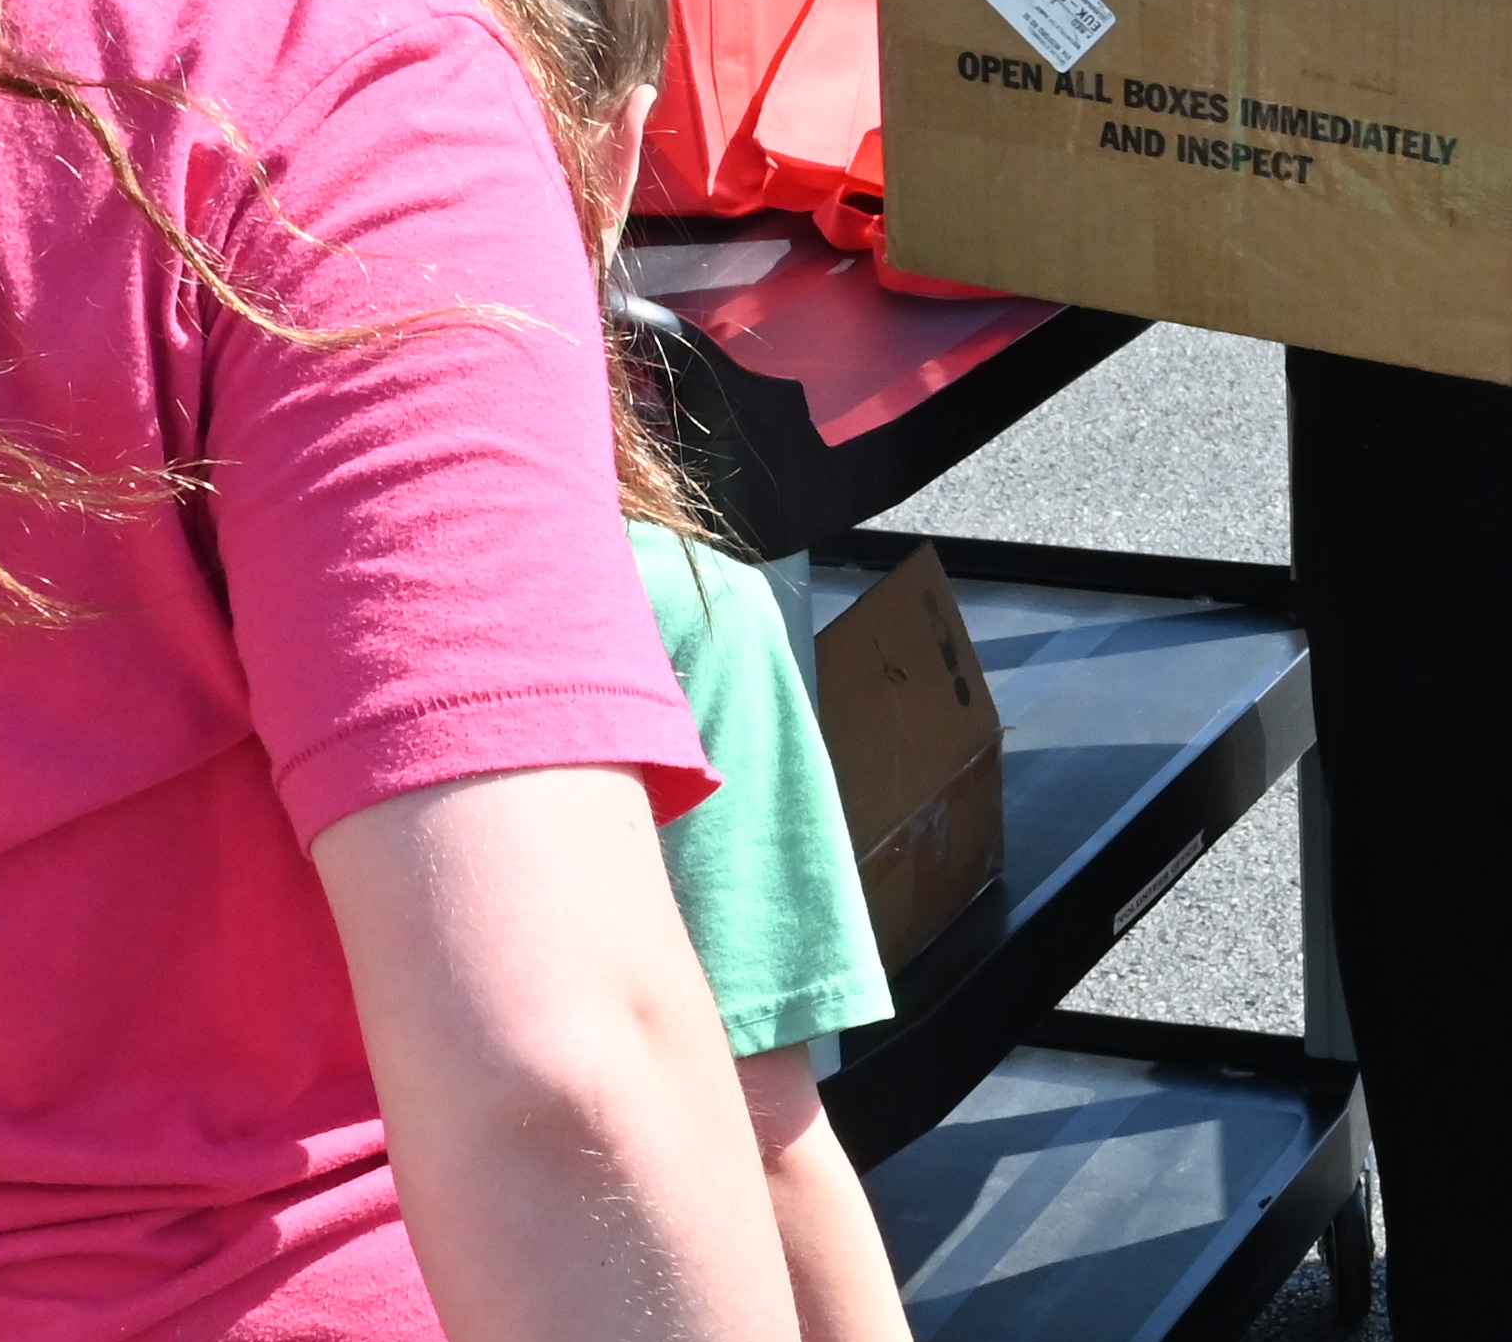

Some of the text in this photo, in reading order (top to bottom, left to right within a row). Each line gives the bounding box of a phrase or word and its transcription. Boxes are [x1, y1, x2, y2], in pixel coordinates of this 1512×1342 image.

[1075, 7, 1102, 32] EUK
[956, 51, 1458, 166] OPEN ALL BOXES IMMEDIATELY
[1099, 119, 1314, 185] AND INSPECT
